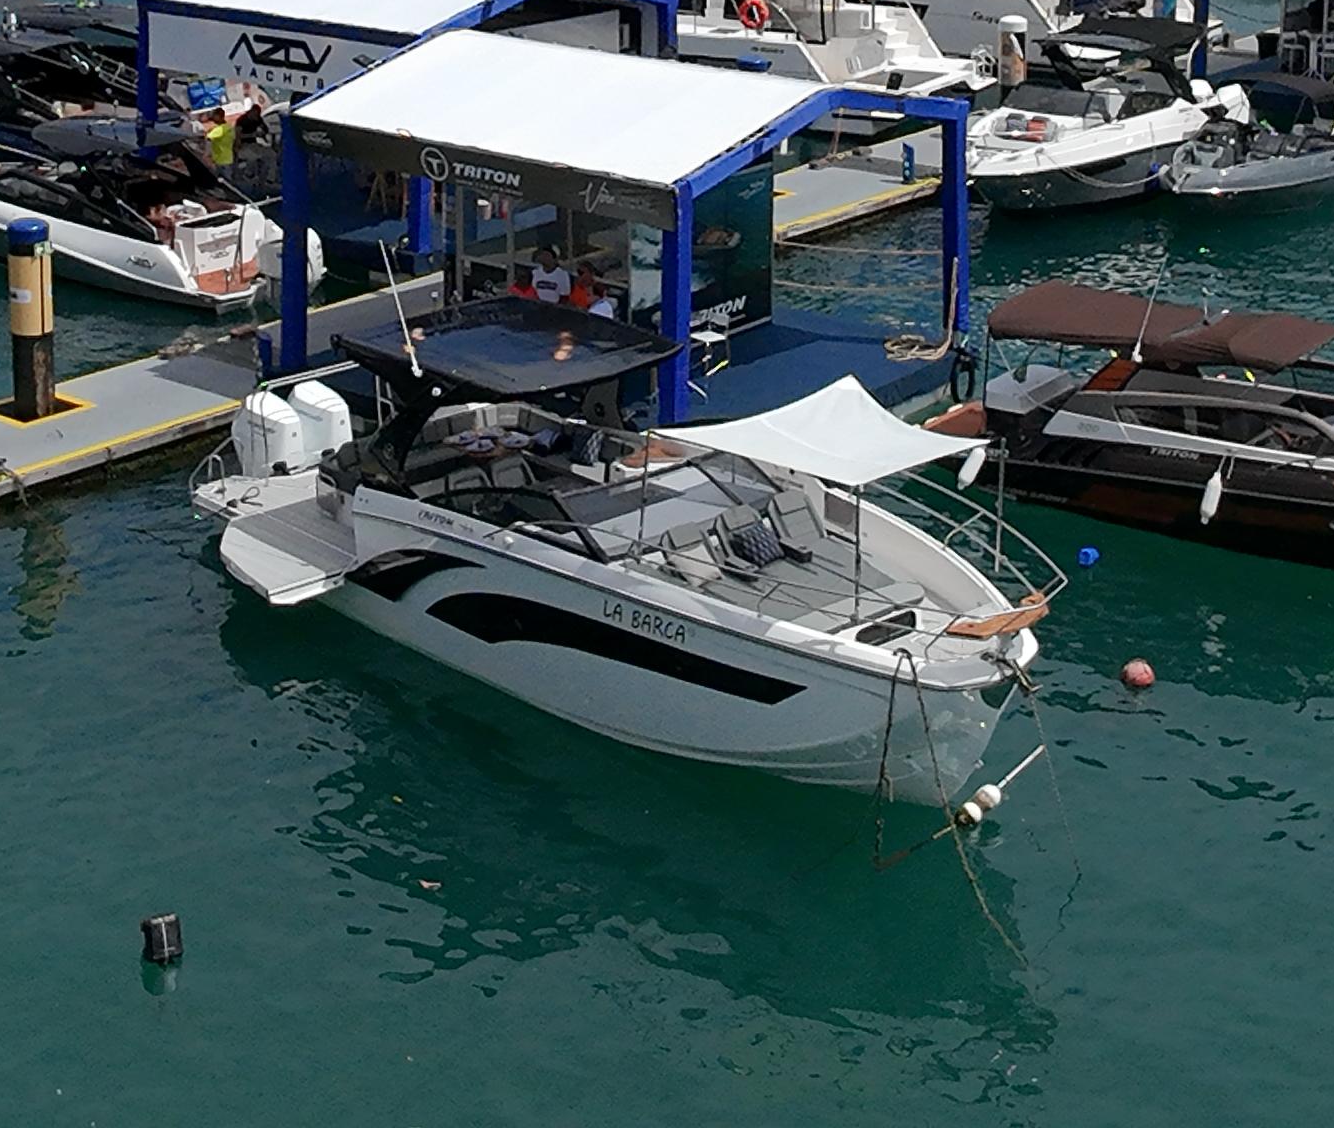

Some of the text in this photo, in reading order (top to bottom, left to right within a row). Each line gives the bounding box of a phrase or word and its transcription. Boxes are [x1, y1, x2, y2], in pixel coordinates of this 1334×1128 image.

[452, 162, 521, 187] TRITON
[603, 599, 686, 644] LA BARCA
